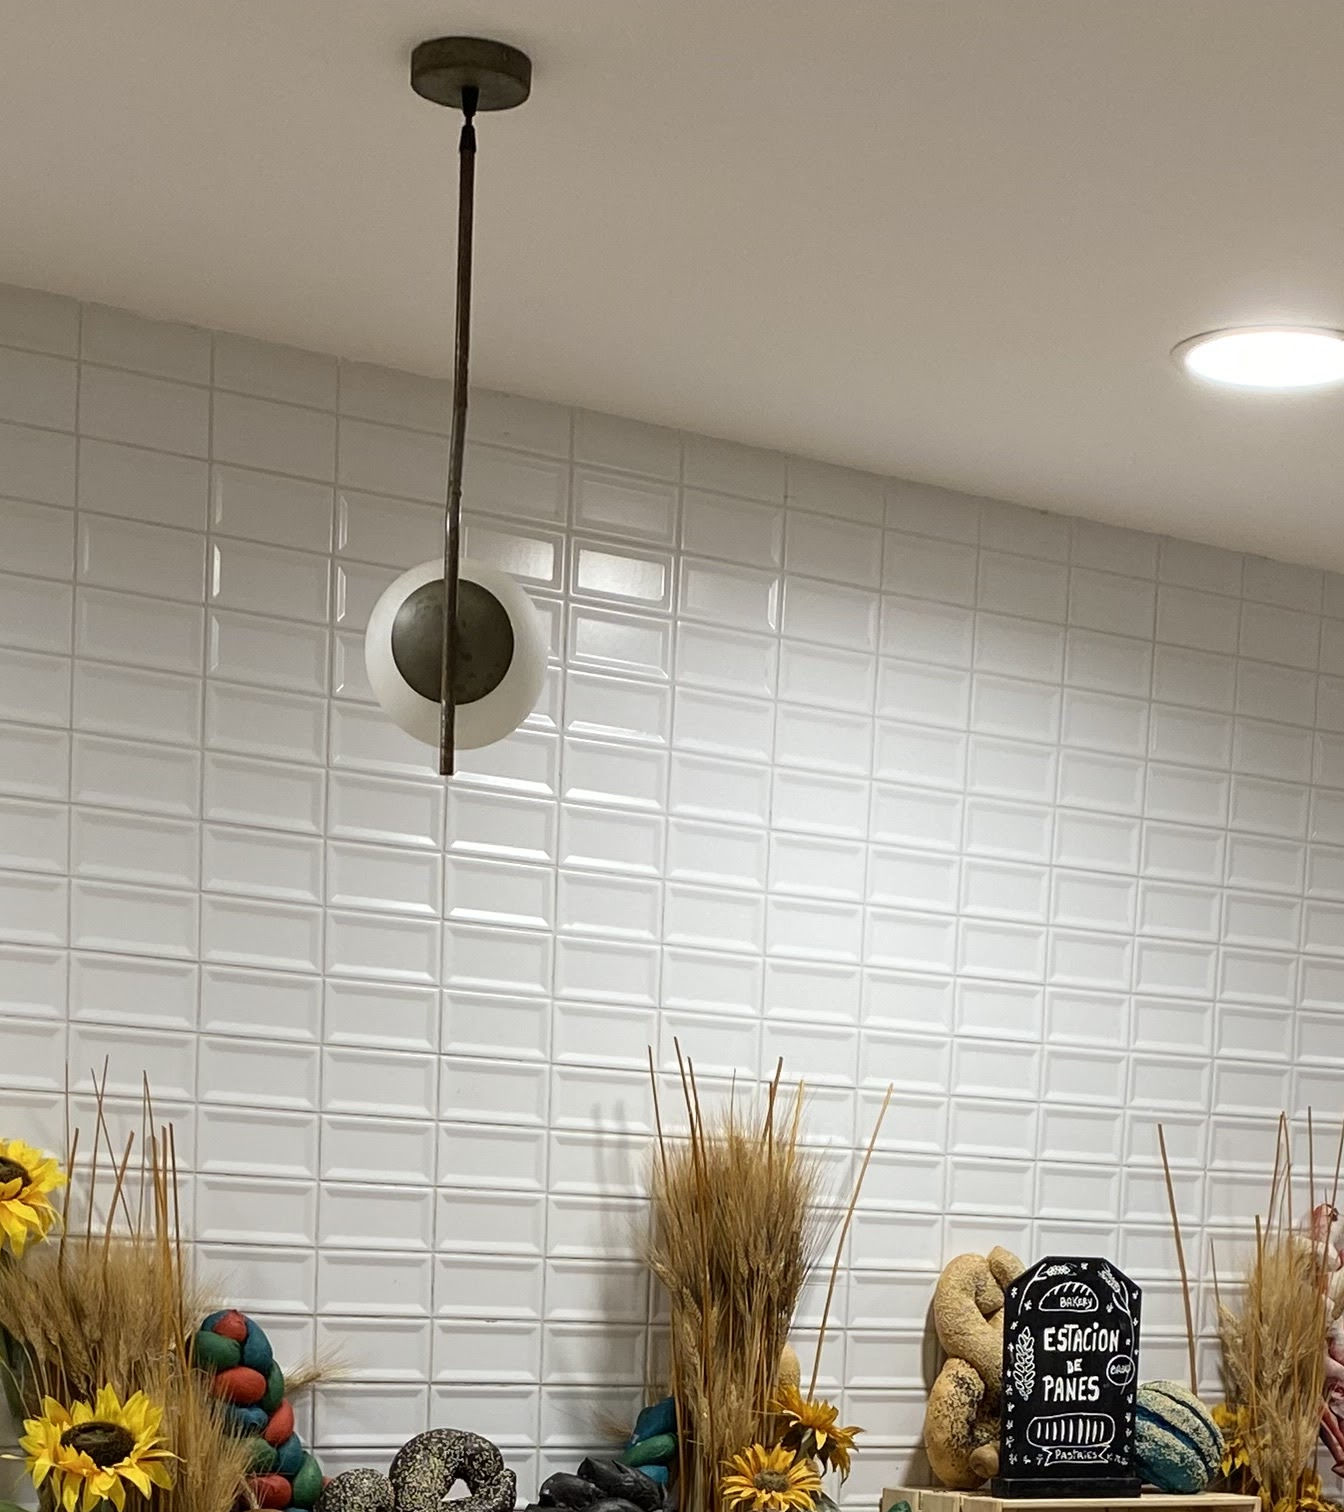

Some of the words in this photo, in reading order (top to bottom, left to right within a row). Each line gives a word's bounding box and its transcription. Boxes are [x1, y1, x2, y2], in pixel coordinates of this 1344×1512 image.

[1059, 1296, 1093, 1310] BAKERY
[1066, 1358, 1083, 1374] DE
[1042, 1375, 1100, 1401] PANES
